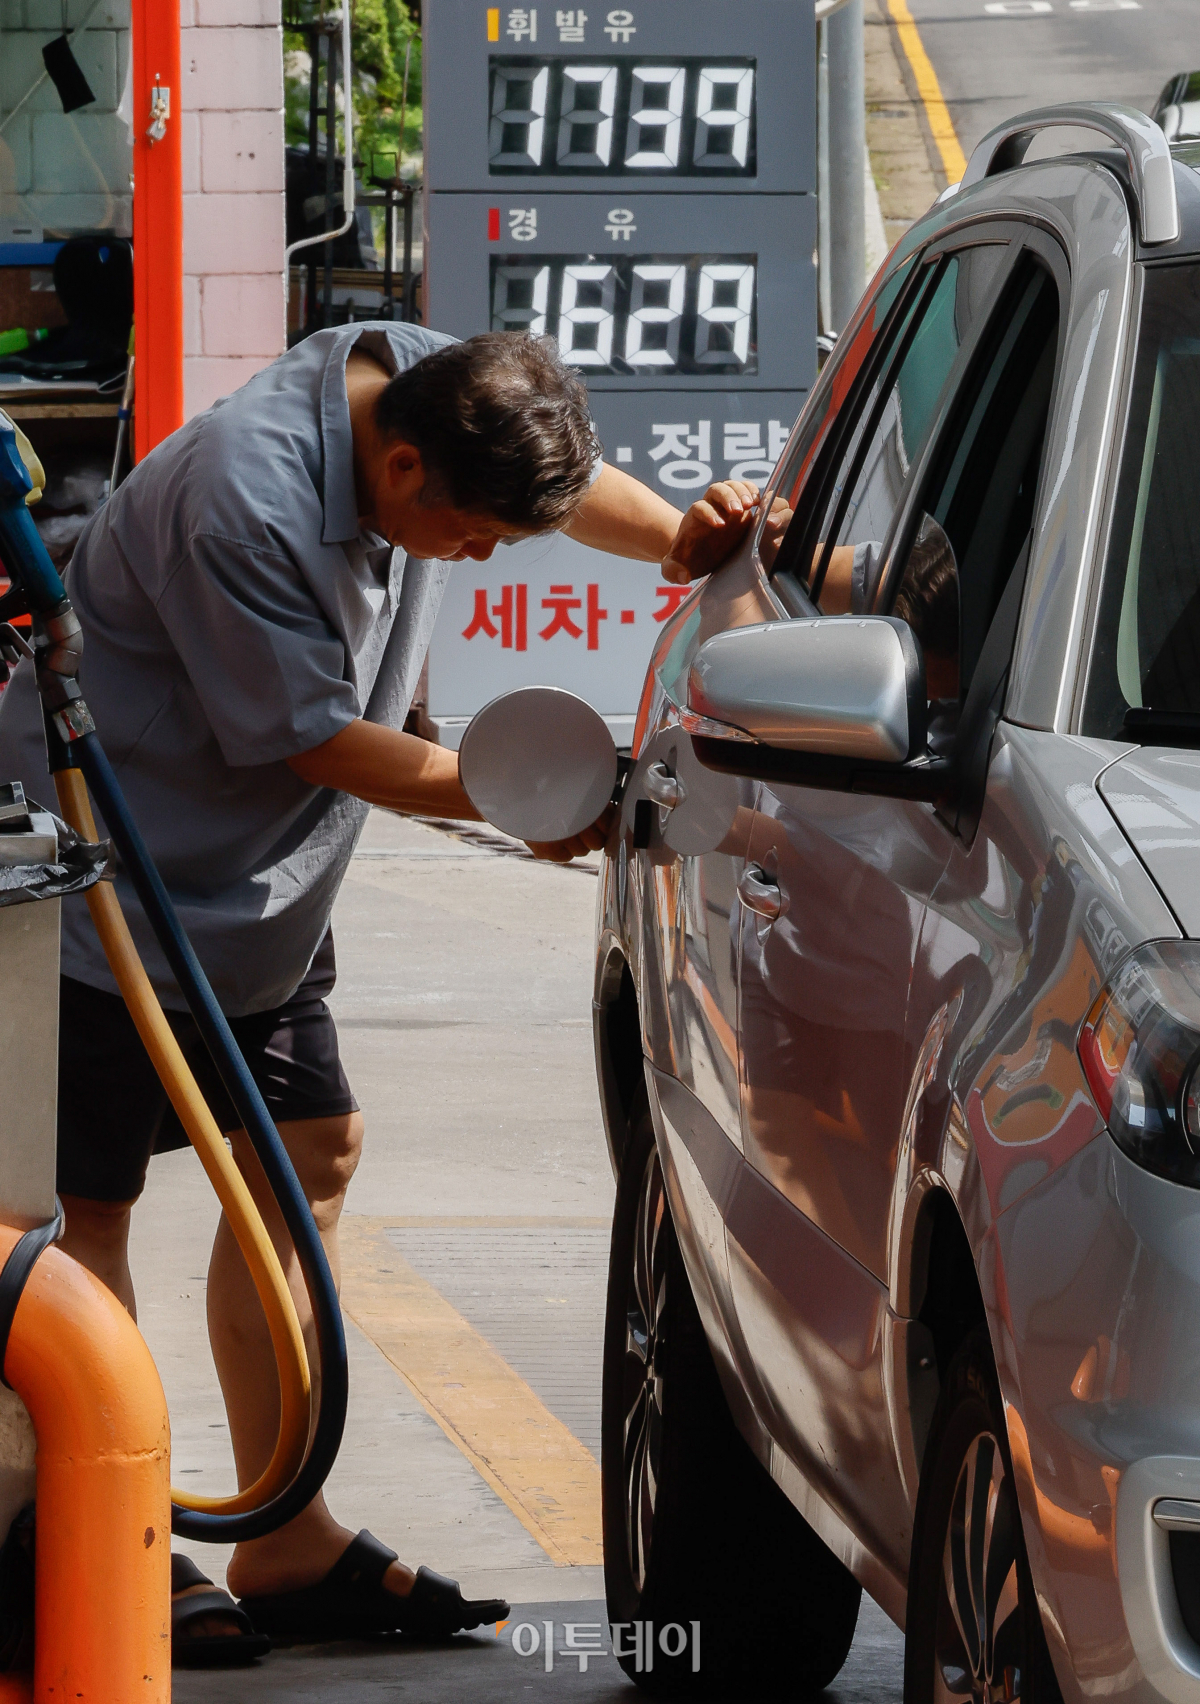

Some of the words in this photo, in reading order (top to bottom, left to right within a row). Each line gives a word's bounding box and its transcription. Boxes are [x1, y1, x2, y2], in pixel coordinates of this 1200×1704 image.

[527, 66, 754, 168] 1739
[529, 264, 755, 366] 1629
[590, 419, 790, 489] ·정량
